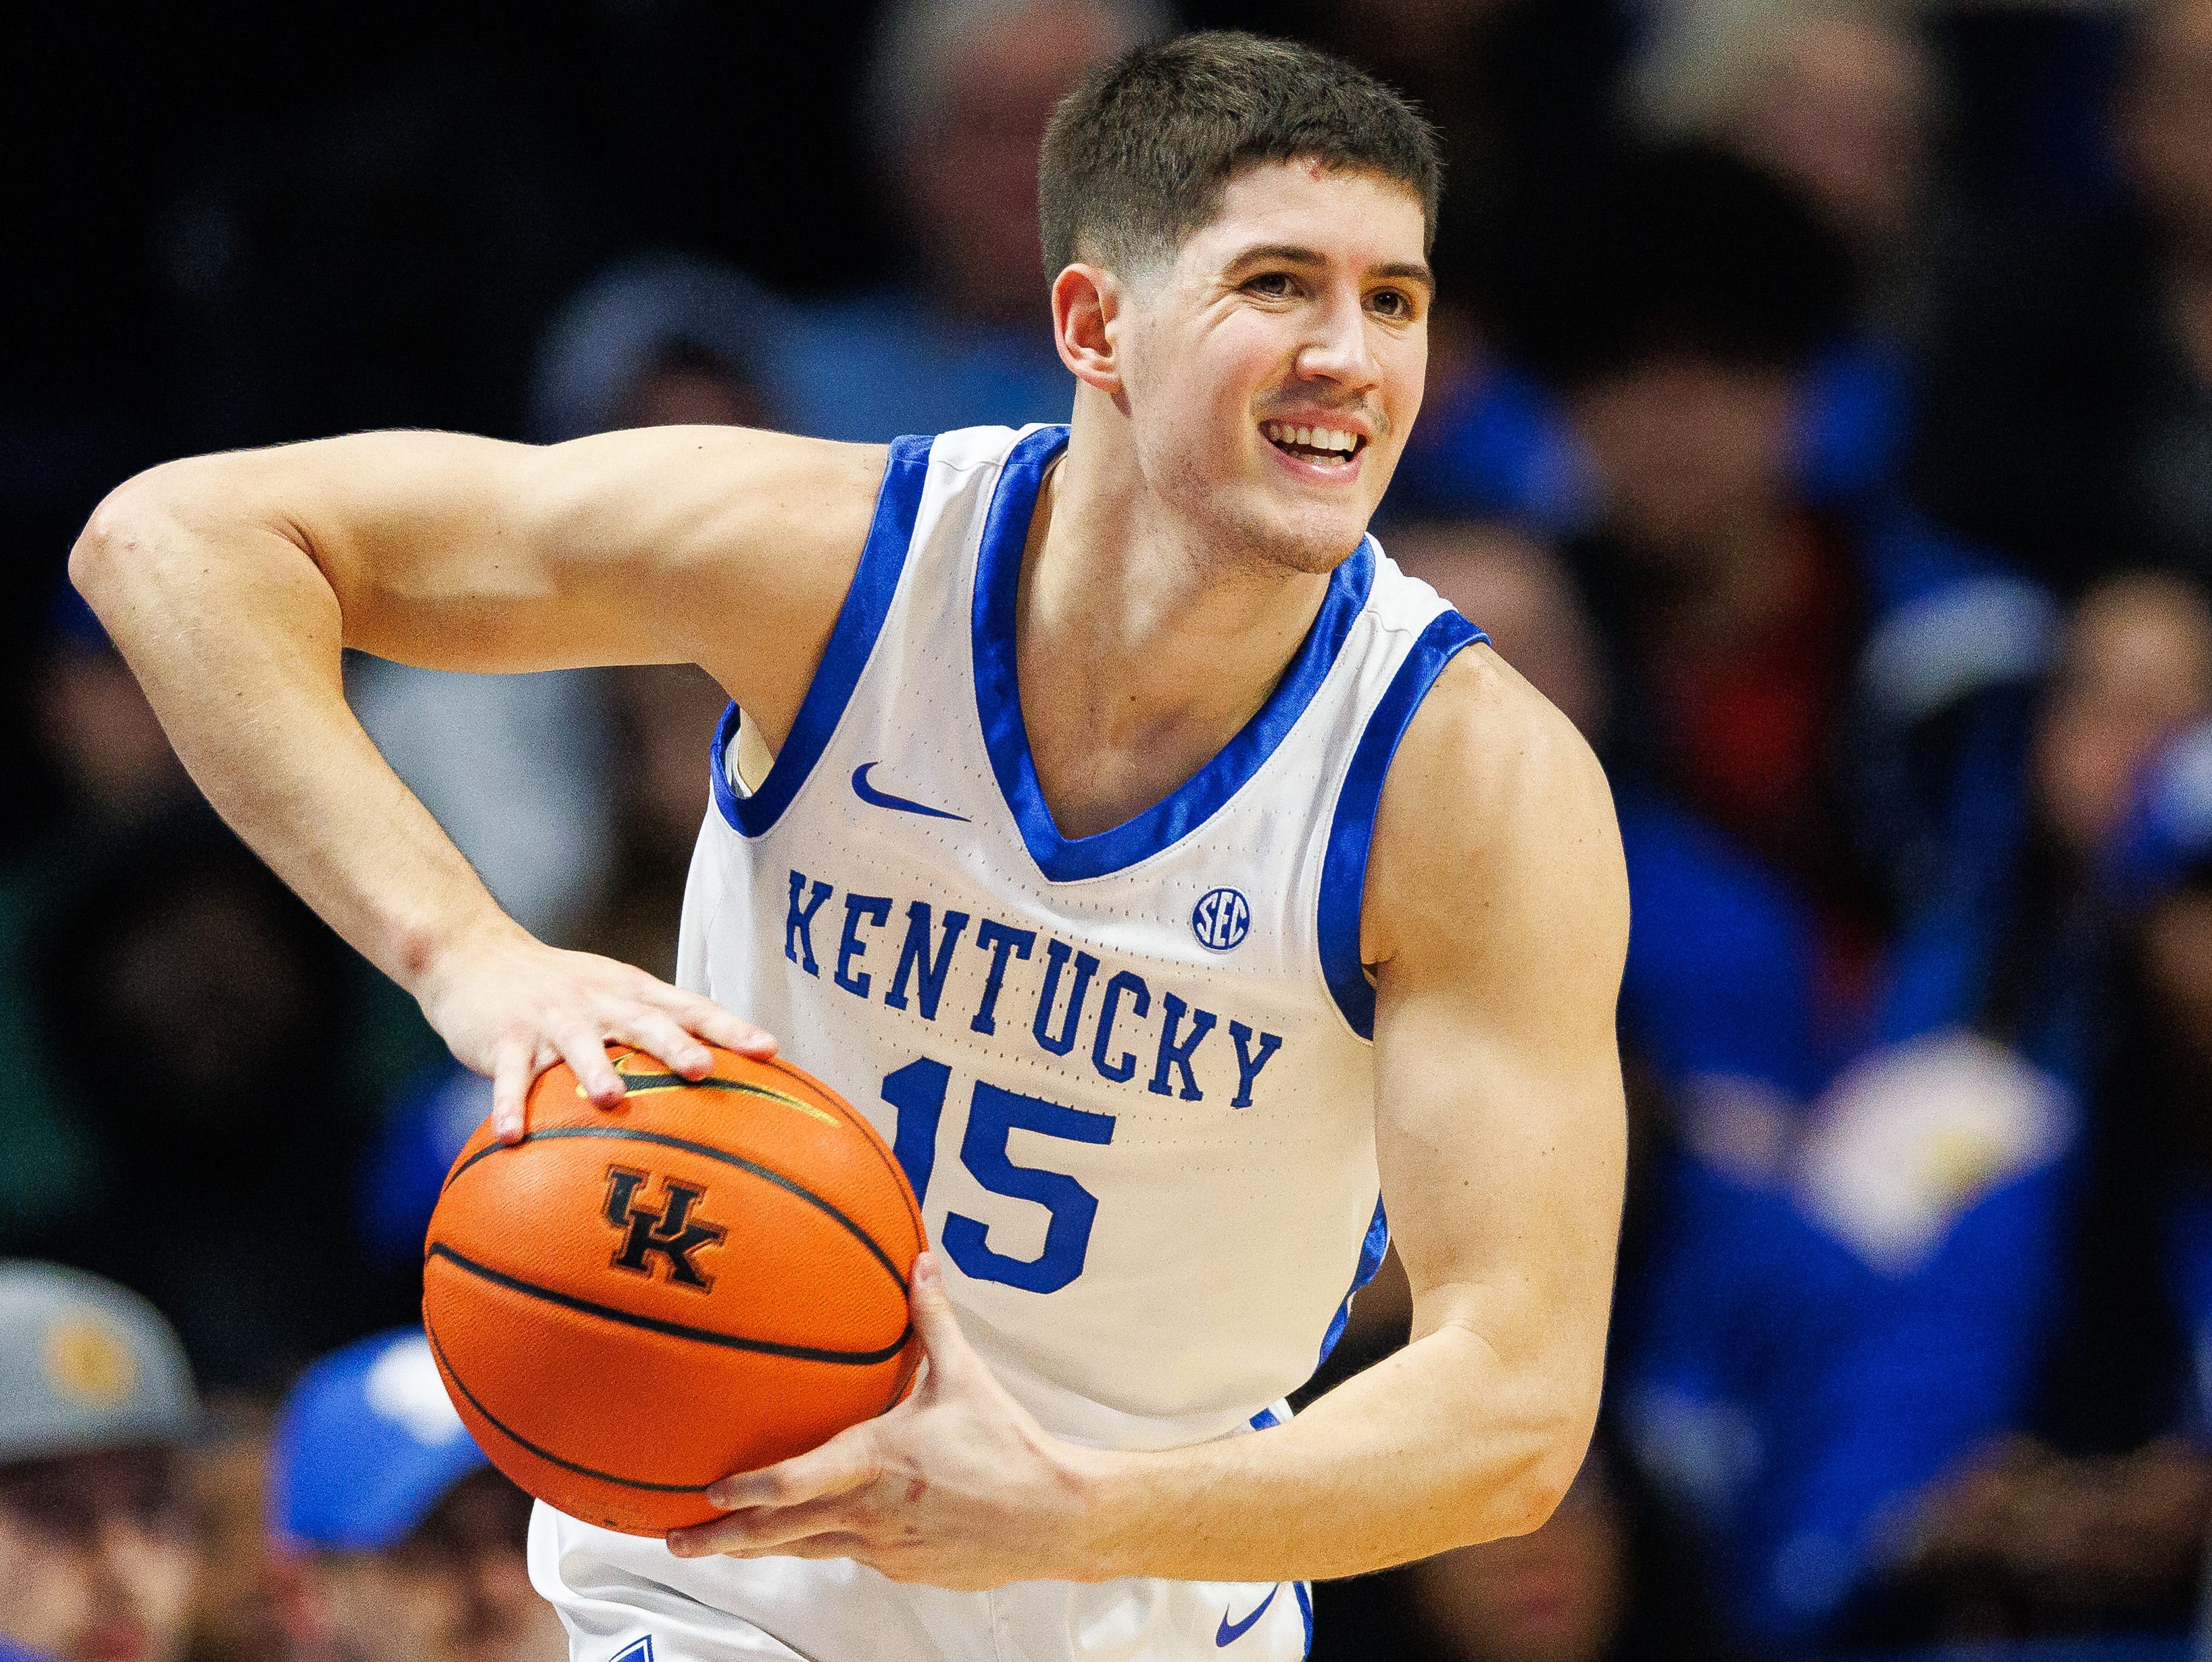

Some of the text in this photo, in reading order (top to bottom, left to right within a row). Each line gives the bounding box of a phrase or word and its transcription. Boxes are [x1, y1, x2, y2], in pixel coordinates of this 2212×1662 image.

[785, 870, 1282, 1109] KENTUCKY
[1196, 891, 1247, 948] SEC
[604, 1166, 726, 1292] UK
[881, 1056, 1116, 1294] 15
